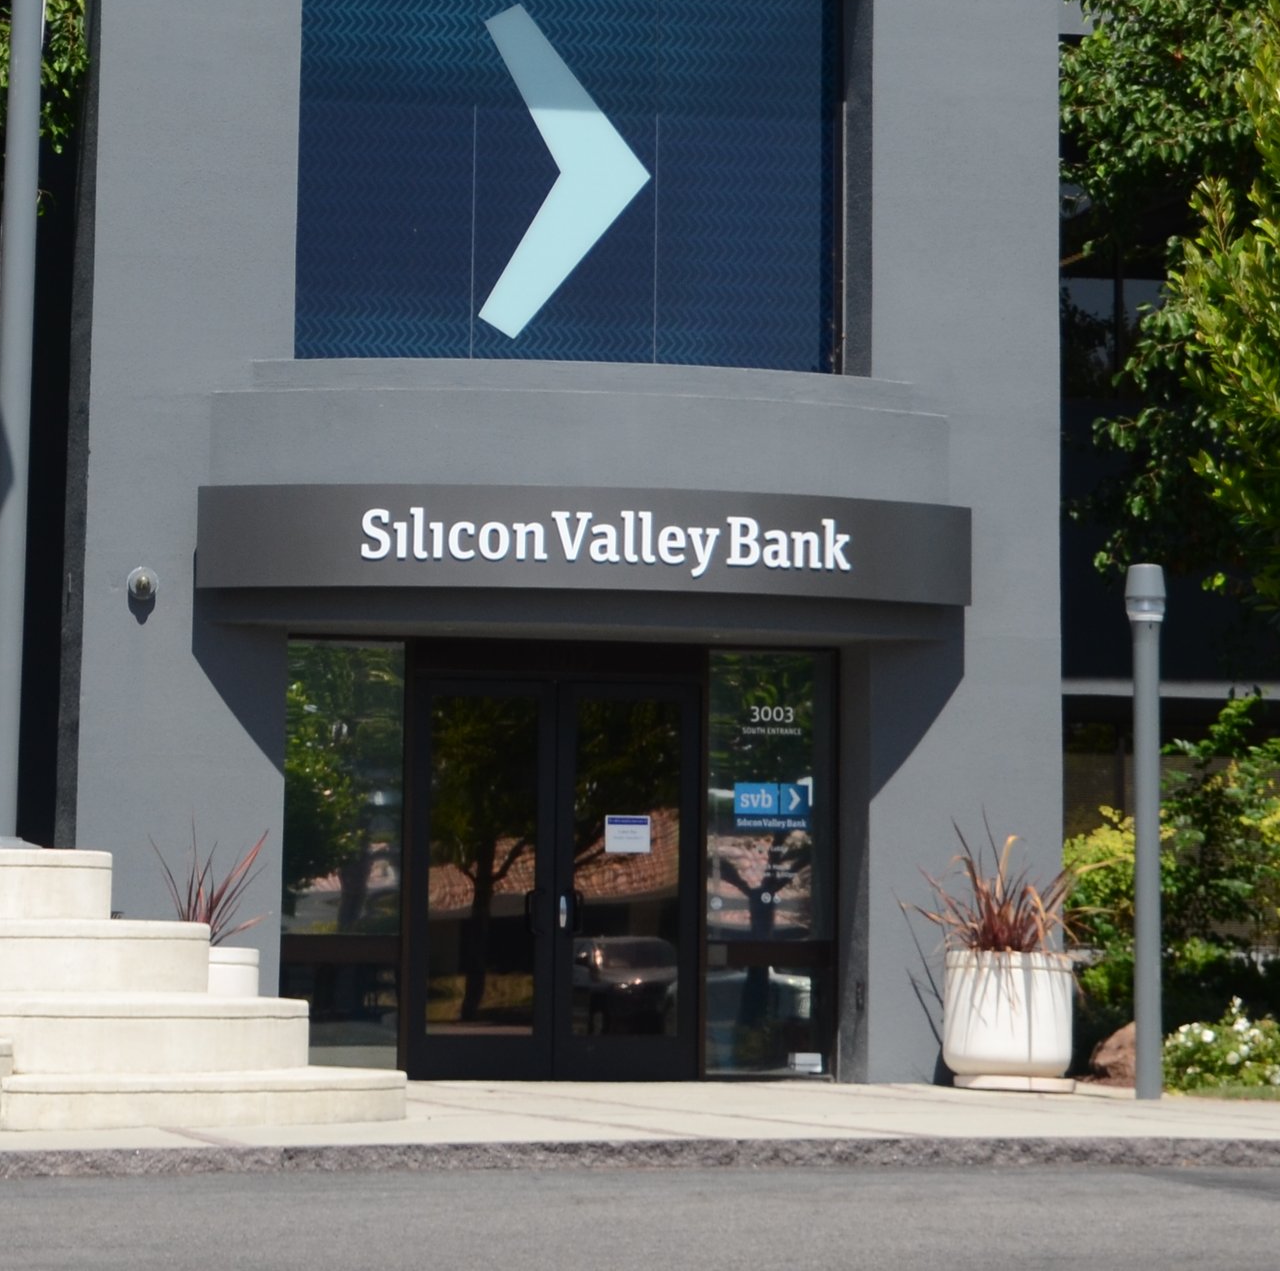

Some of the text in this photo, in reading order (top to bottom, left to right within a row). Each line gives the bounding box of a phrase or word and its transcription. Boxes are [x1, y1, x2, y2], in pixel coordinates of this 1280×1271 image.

[360, 507, 852, 578] Silicon Valley Bank
[750, 706, 794, 723] 3003
[742, 727, 801, 735] SOUTH ENTRANCE
[740, 788, 773, 808] svb
[762, 818, 786, 829] Valley
[786, 818, 807, 828] Bank
